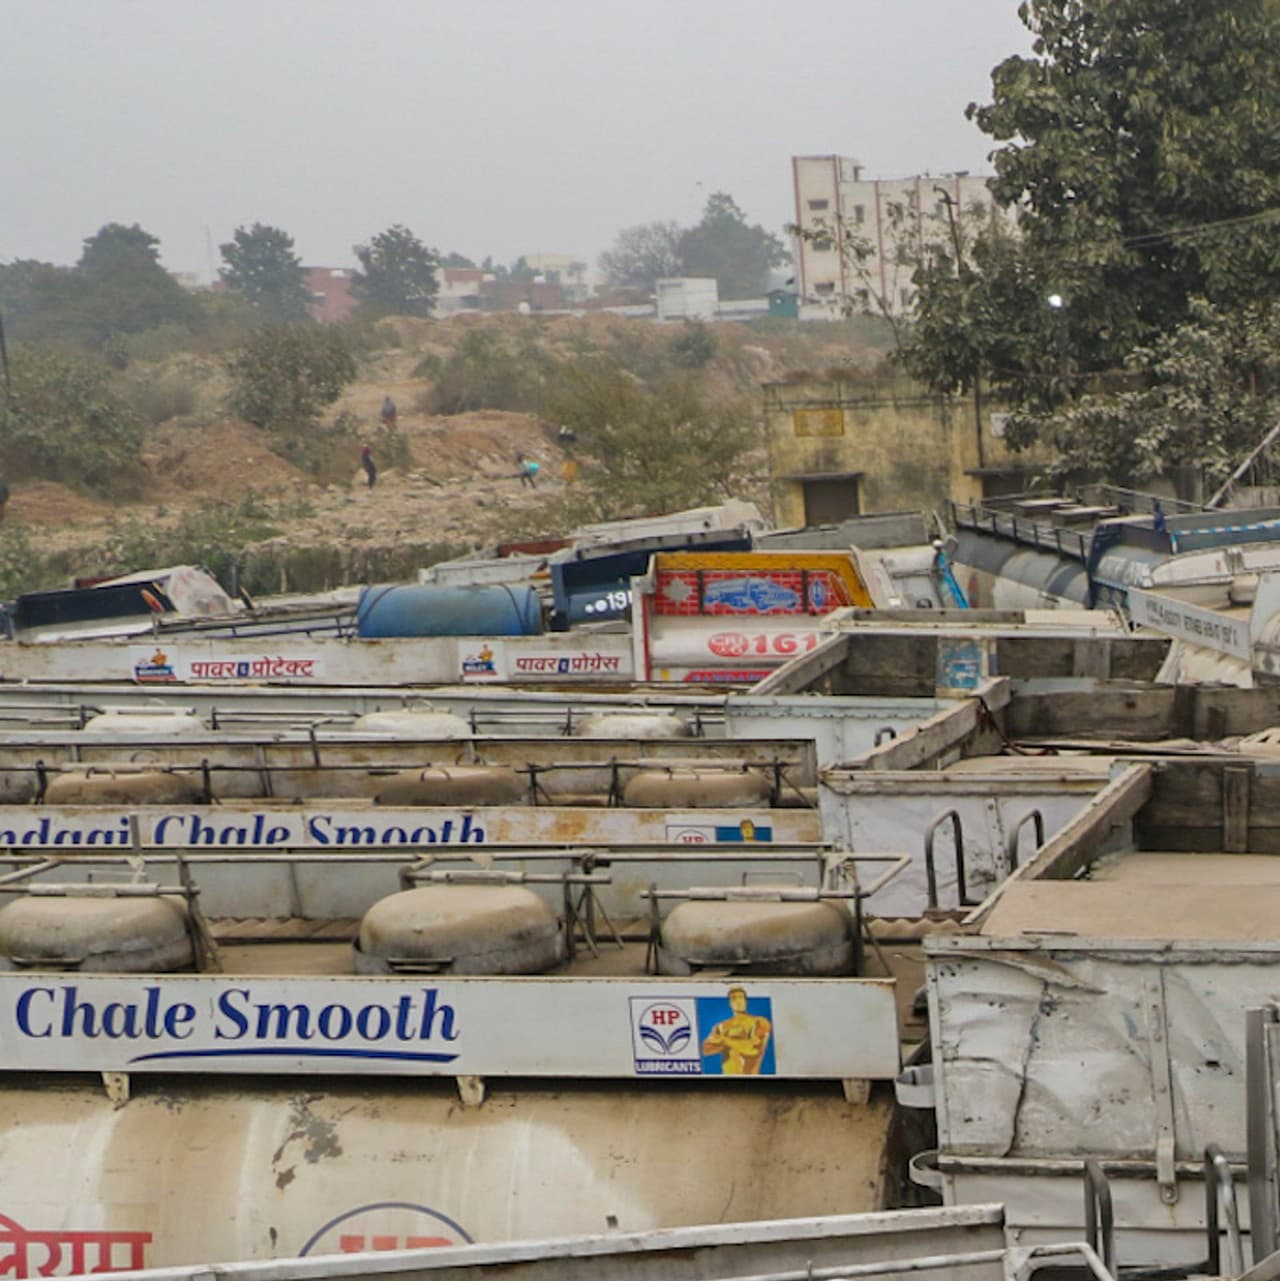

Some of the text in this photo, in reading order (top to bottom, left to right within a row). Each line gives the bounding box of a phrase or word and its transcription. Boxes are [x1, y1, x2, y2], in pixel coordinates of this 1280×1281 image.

[16, 986, 459, 1041] Chale Smooth
[651, 1010, 681, 1025] HP
[636, 1060, 701, 1074] LUBRICANTS
